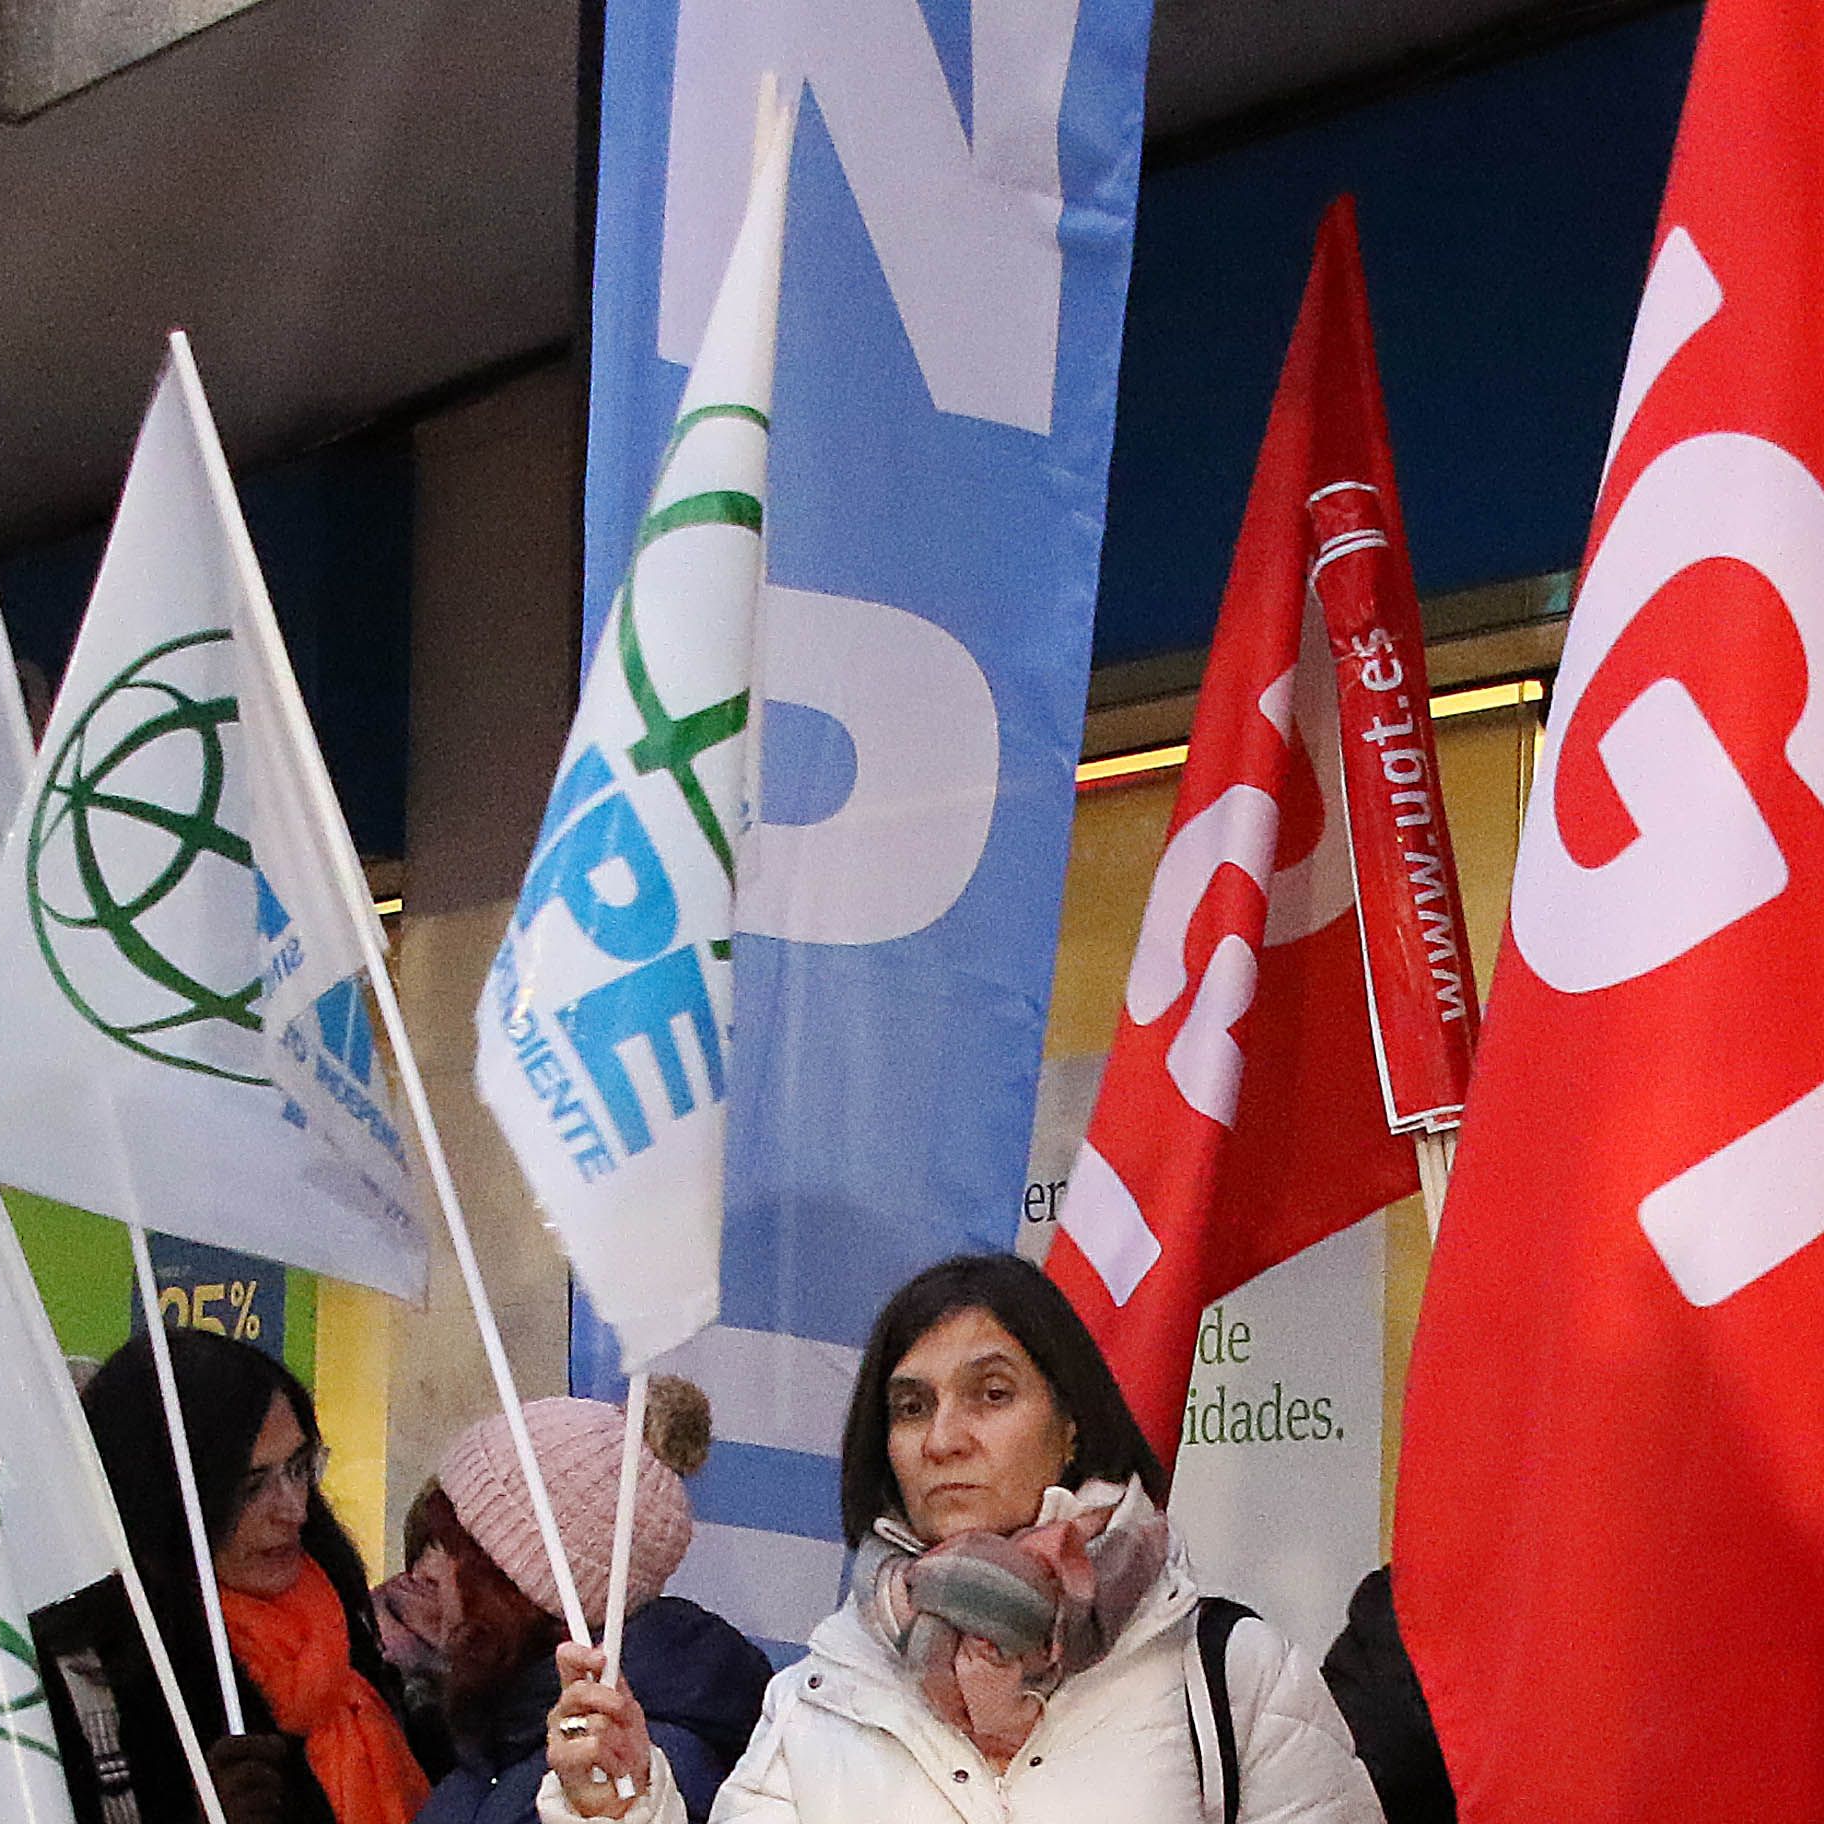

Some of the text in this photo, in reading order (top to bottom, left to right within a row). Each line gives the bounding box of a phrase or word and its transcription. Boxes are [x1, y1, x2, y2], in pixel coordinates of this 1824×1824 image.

[1351, 627, 1467, 1023] www.ugt.es
[1023, 1180, 1068, 1223] er
[1198, 1304, 1252, 1365] de
[1183, 1380, 1345, 1446] idades.
